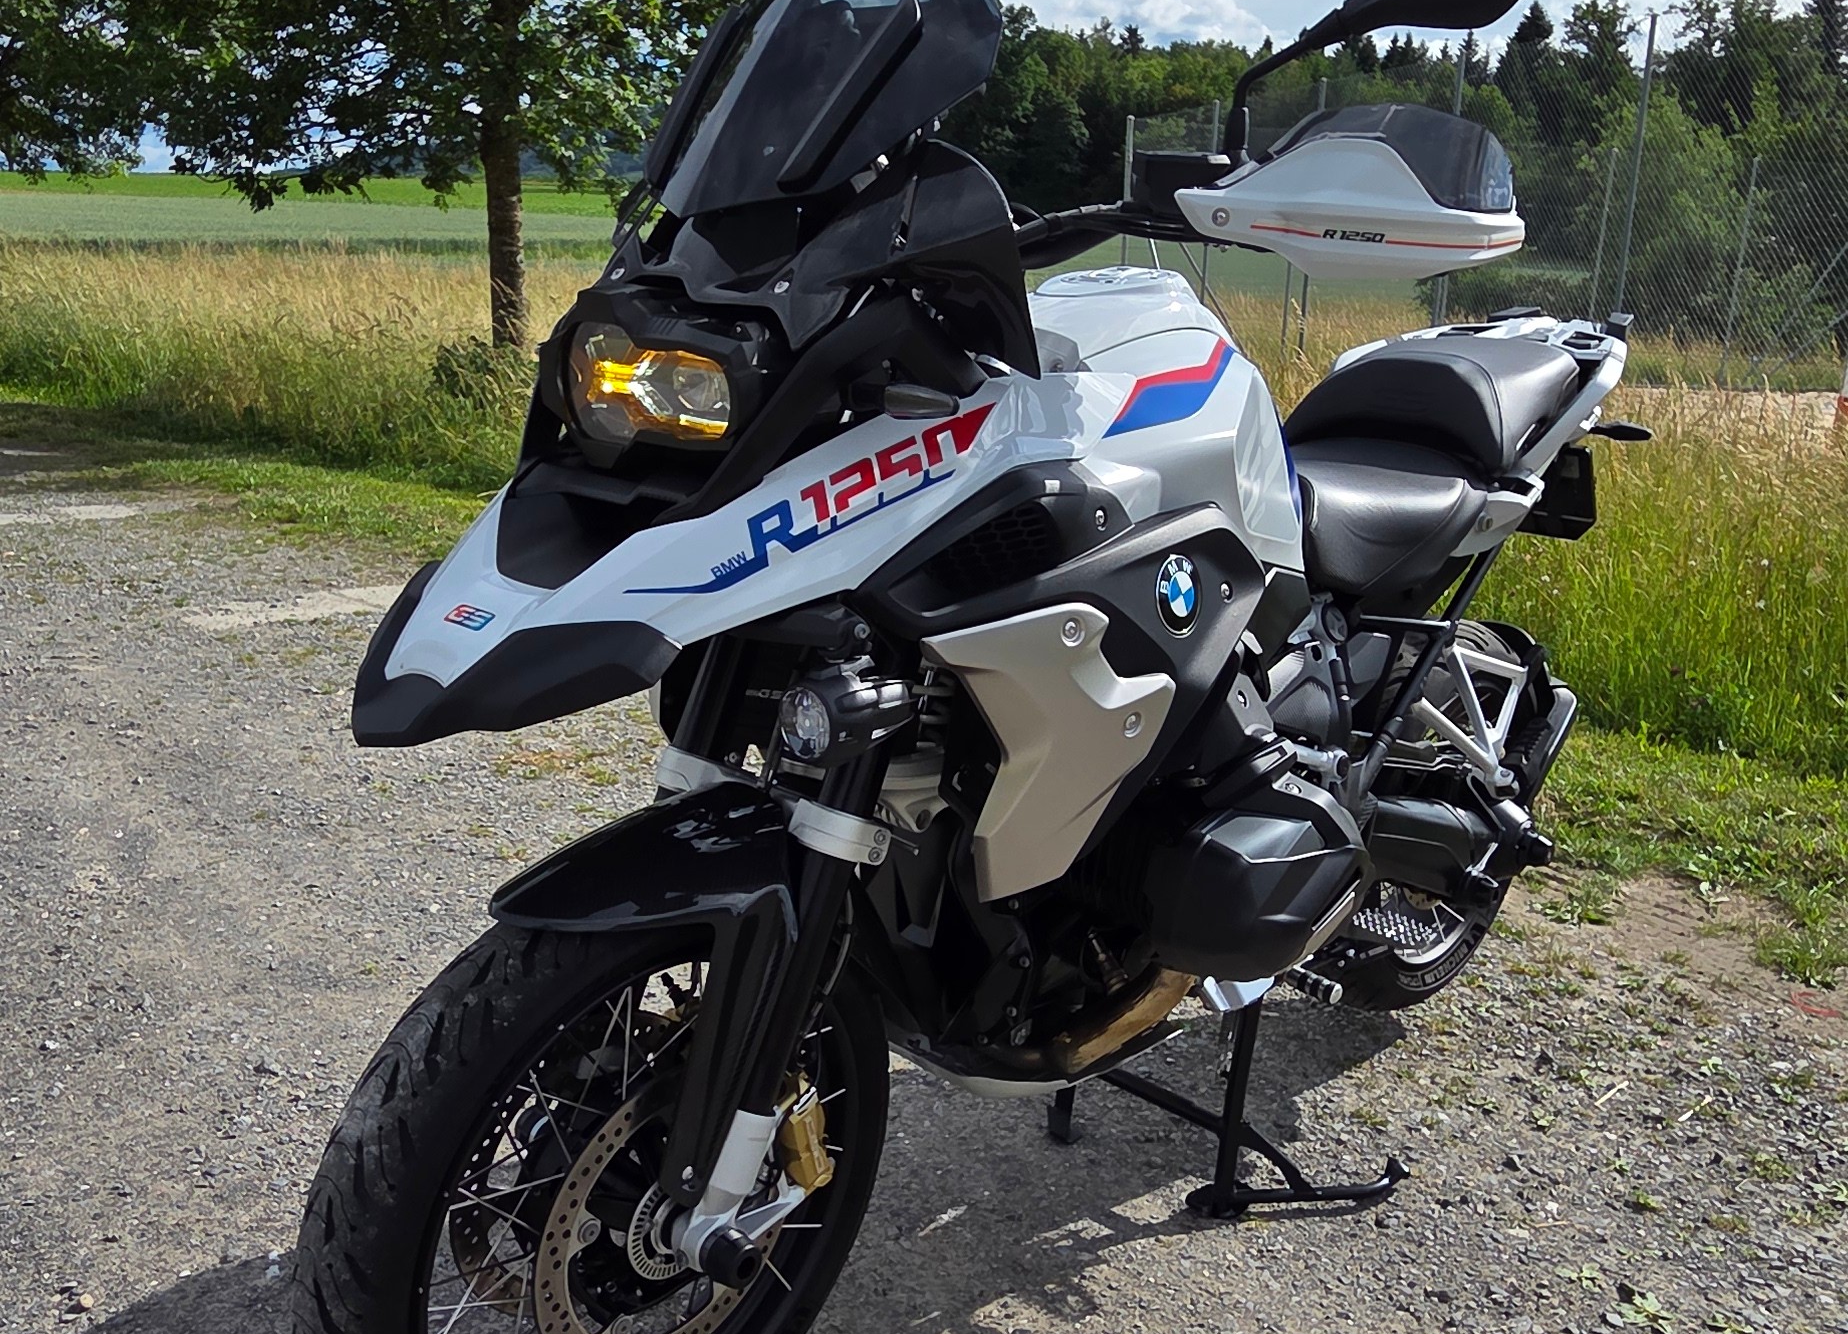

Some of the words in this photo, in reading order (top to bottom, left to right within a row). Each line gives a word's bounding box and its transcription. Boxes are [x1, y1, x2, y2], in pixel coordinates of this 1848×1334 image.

[1323, 229, 1338, 239] R
[1339, 230, 1386, 243] 1250
[710, 550, 747, 580] BMW
[1160, 559, 1194, 595] BMW
[1423, 942, 1469, 985] MICHELIN
